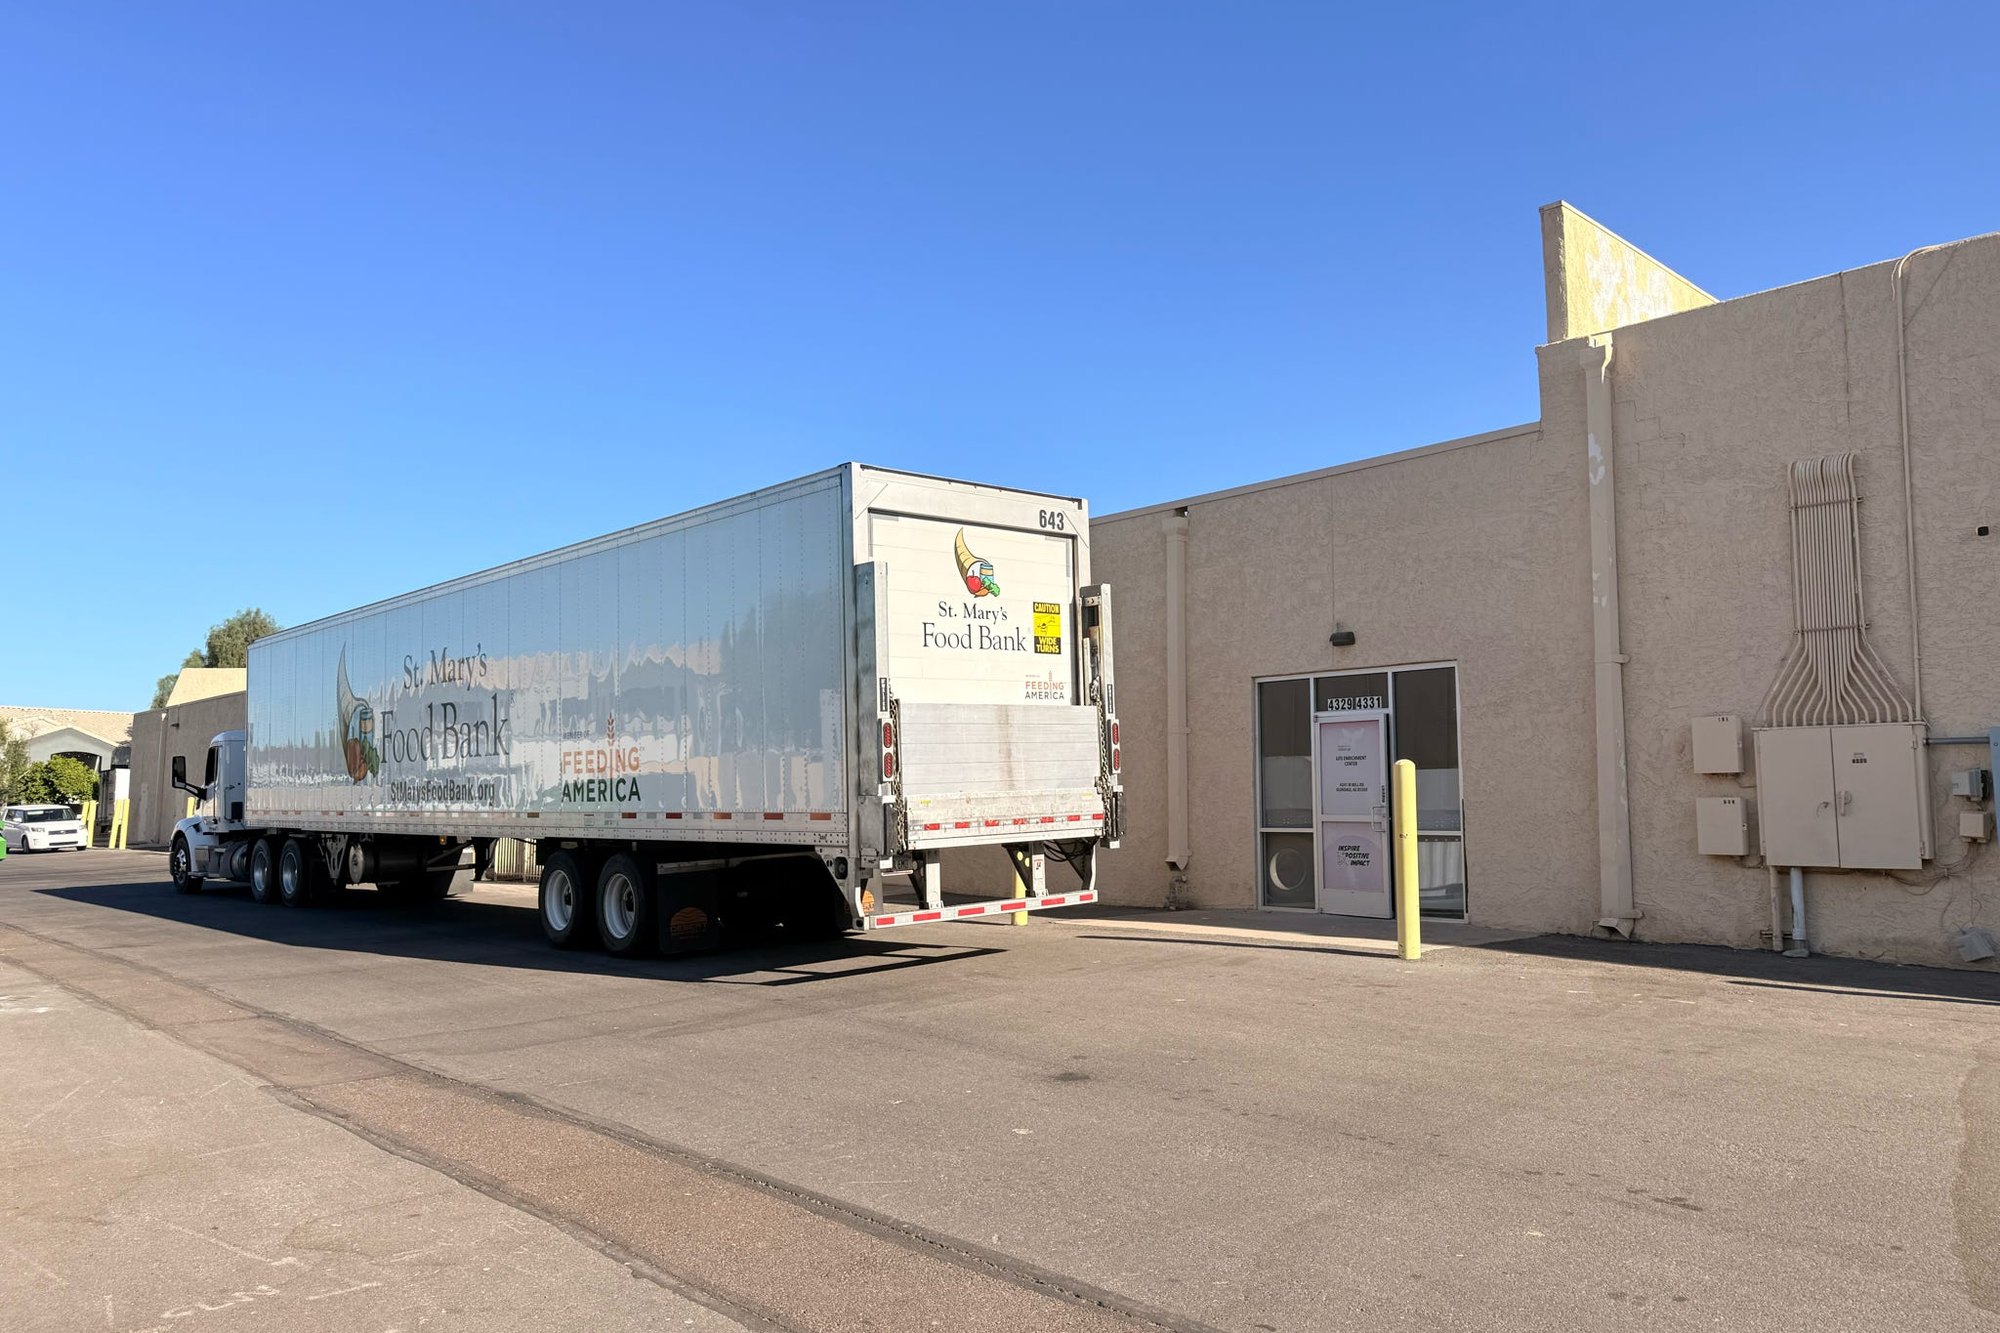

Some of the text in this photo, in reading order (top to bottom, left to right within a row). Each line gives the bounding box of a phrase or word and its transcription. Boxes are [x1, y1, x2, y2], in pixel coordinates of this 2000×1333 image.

[1039, 509, 1064, 531] 643
[938, 600, 1008, 625] St. Mary's
[1034, 602, 1060, 613] CAUTION
[922, 621, 1028, 652] Food Bank
[1036, 644, 1060, 654] TURNS
[1038, 636, 1058, 645] WIDE
[403, 642, 487, 692] St. Mary's
[1024, 691, 1065, 701] AMERICA
[1025, 681, 1065, 691] FEEDING
[381, 692, 509, 764] Food Bank
[562, 746, 640, 775] FEEDING
[391, 778, 495, 806] StMarysFoodBank.org
[561, 777, 641, 803] AMERICA
